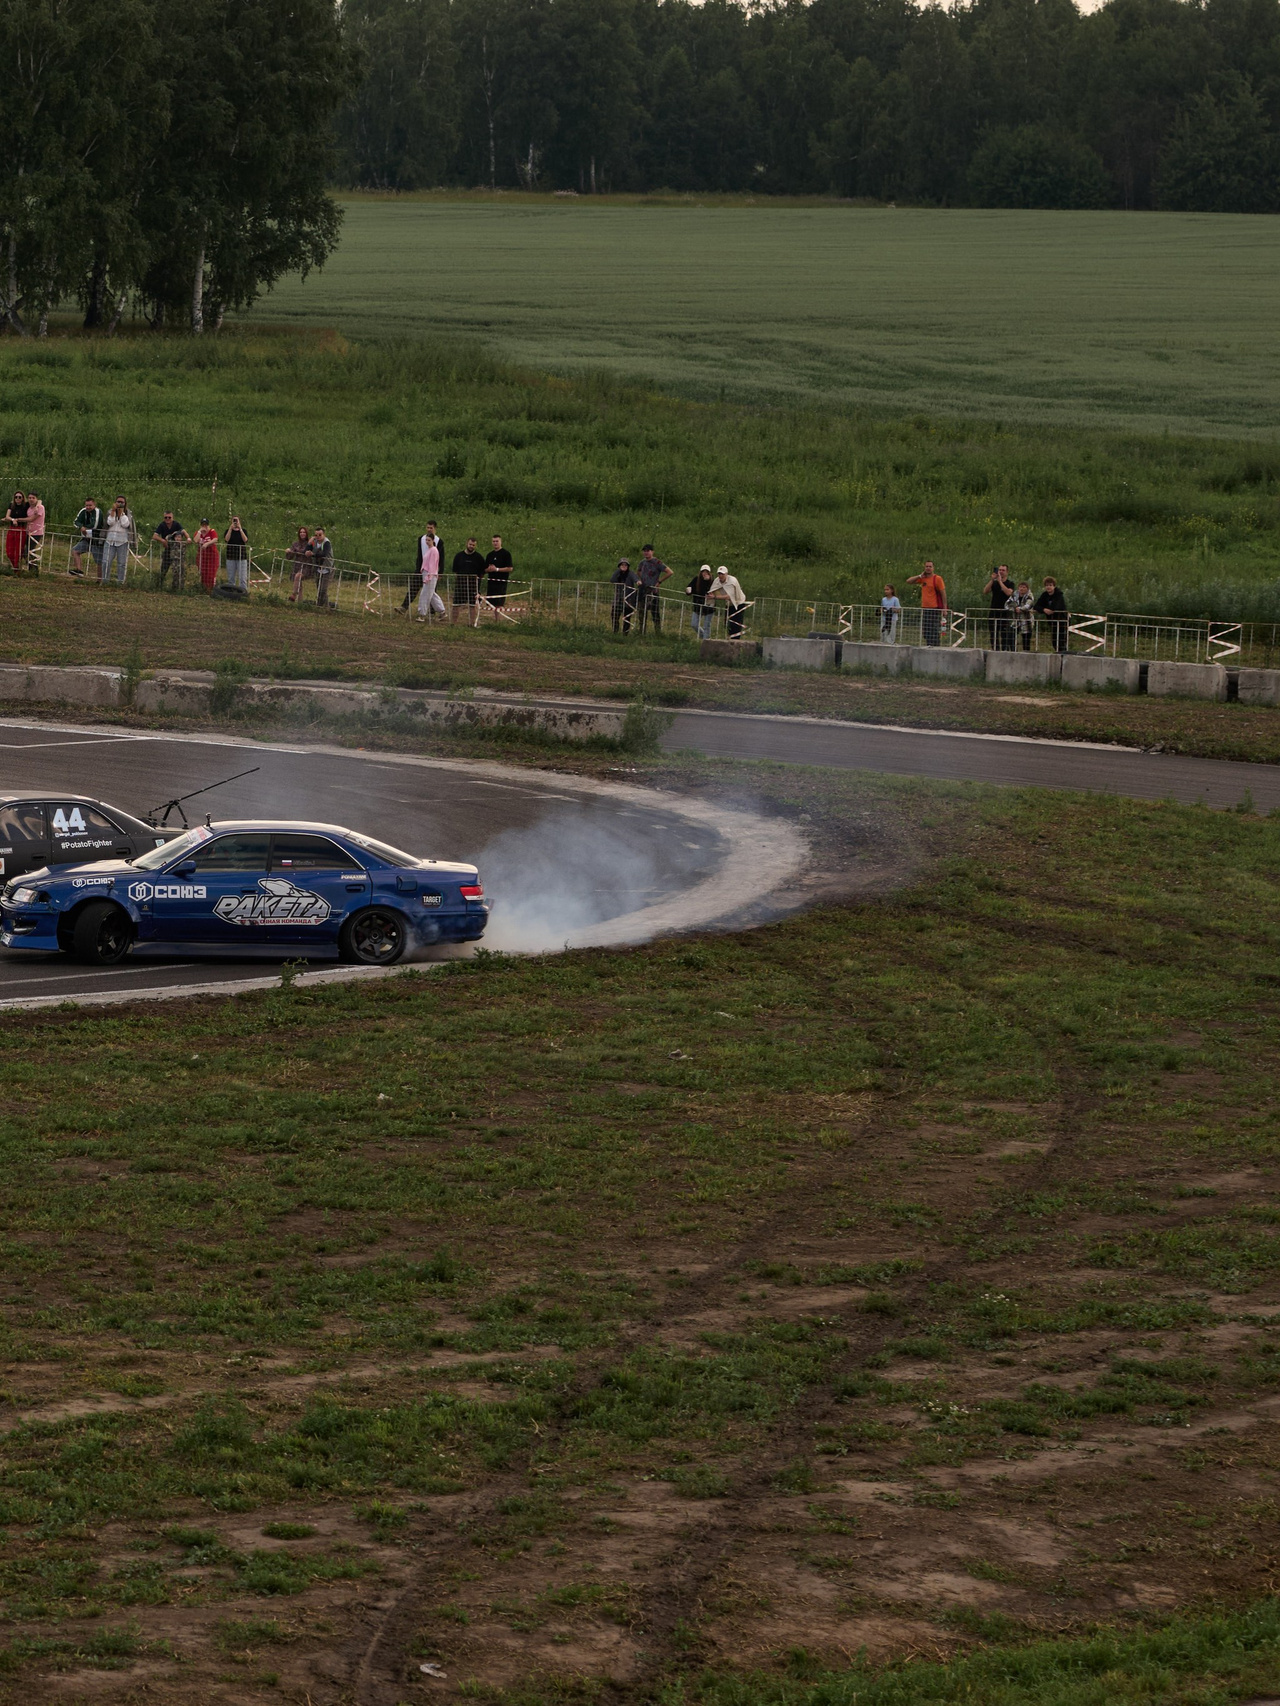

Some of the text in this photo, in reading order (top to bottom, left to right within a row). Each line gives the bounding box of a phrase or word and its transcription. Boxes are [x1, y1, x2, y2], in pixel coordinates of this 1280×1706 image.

[52, 807, 86, 832] 44
[61, 840, 112, 849] #PotatoFighter
[154, 885, 207, 899] СОЮЗ
[214, 896, 329, 919] РАКЕТА
